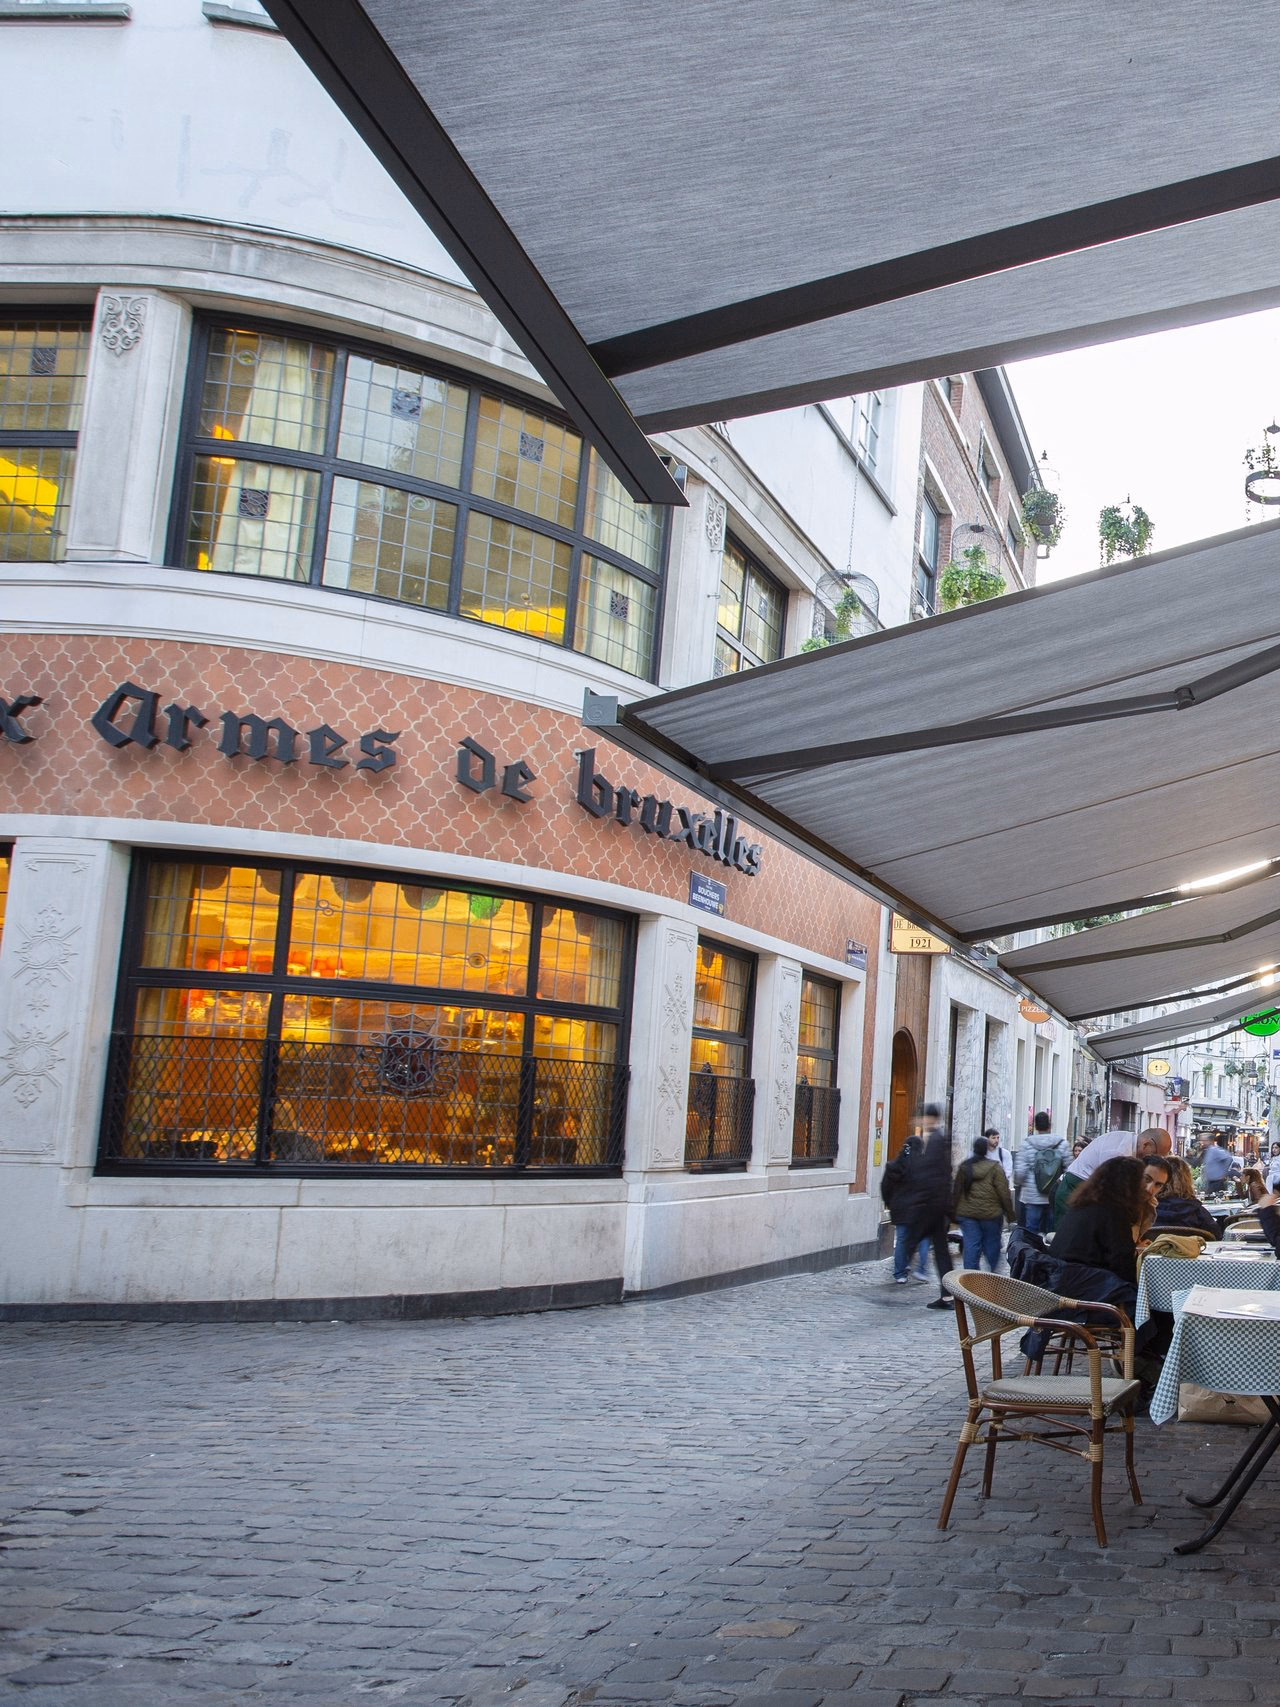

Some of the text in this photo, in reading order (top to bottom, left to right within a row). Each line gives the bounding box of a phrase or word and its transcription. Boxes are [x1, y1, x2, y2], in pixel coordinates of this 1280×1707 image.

[456, 735, 538, 803] de
[692, 892, 720, 909] BEENHOUWE
[910, 938, 932, 949] 1921
[1021, 1006, 1045, 1014] PIZZE
